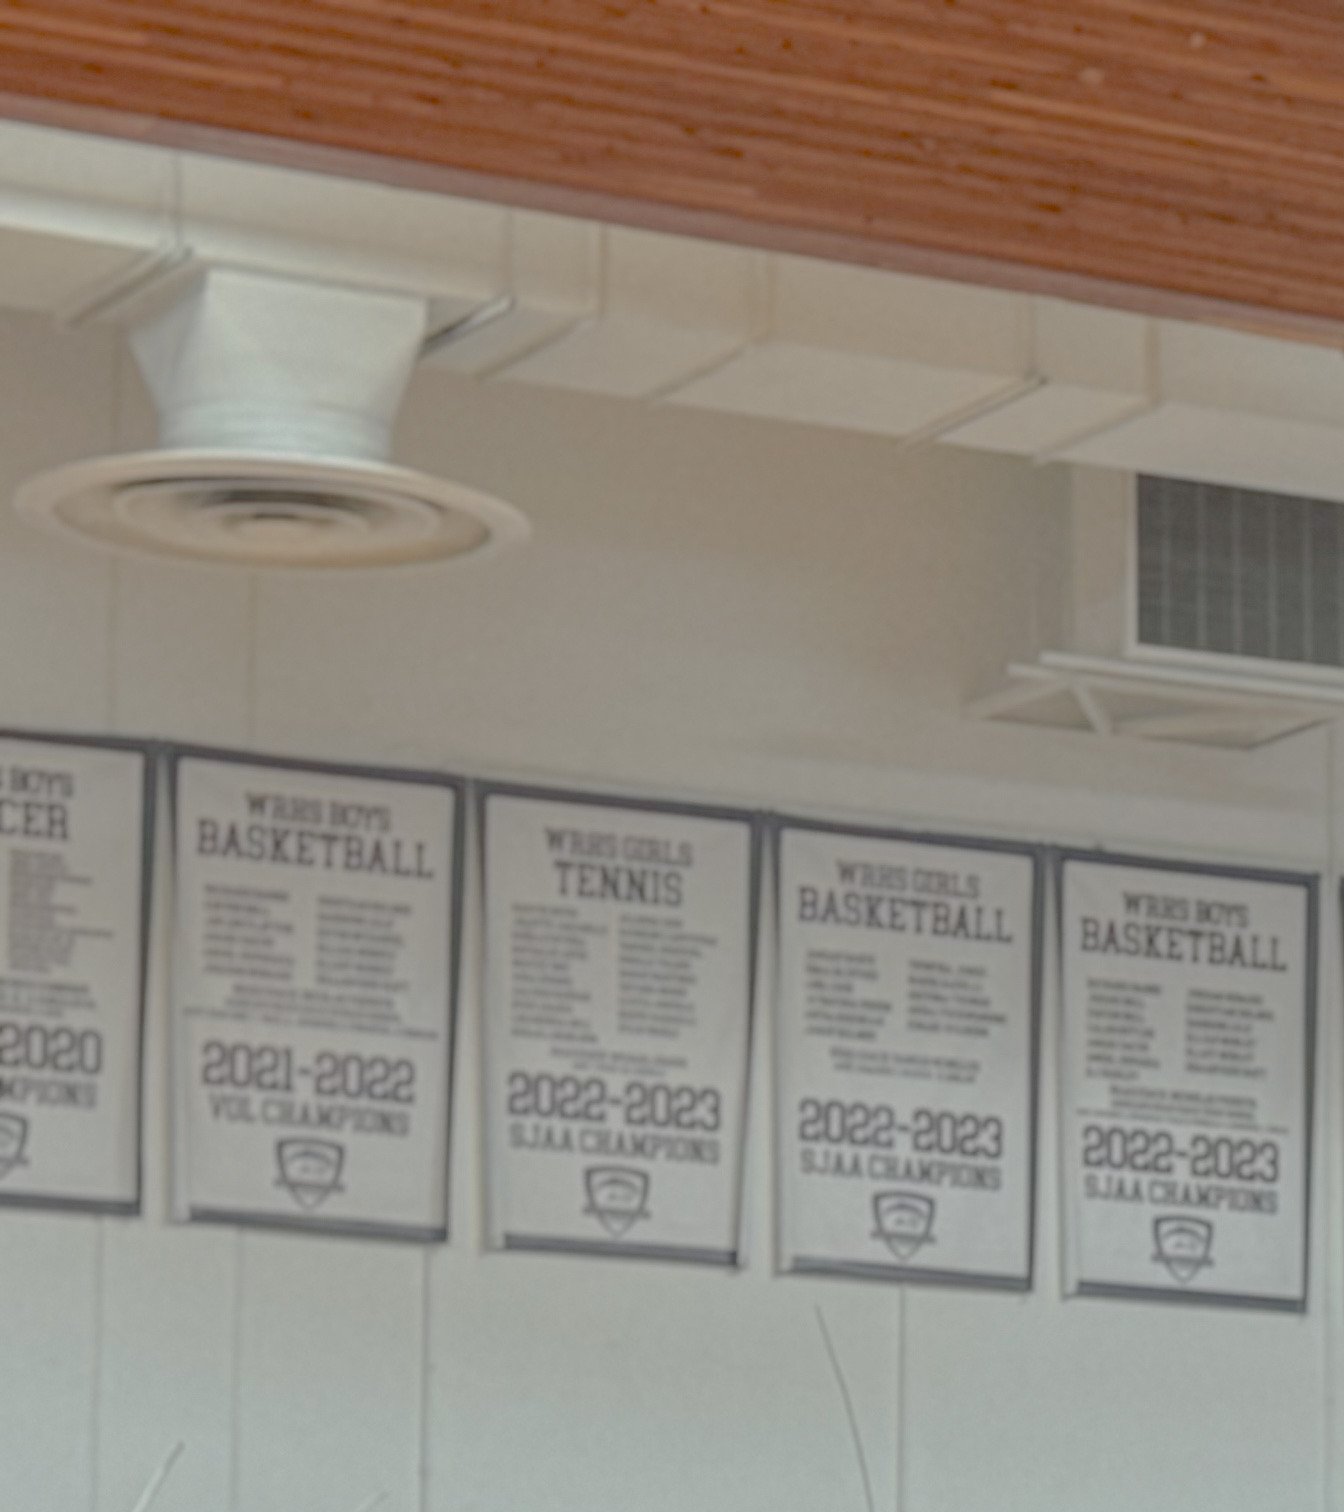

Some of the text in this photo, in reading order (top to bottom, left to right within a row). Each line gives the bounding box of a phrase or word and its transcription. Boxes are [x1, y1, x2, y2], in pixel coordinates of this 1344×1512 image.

[245, 791, 391, 832] WRHS BOYS
[196, 819, 435, 879] BASKETBALL
[545, 827, 693, 868] WRHS GIRLS
[554, 860, 683, 907] TENNIS
[836, 859, 980, 899] WRHS GIRLS
[798, 885, 1013, 943] BASKETBALL
[1122, 892, 1250, 929] WRHS BOYS
[1080, 916, 1287, 972] BASKETBALL
[202, 1040, 415, 1104] 2021-2022
[261, 1097, 411, 1137] CHAMPIONS
[507, 1070, 720, 1132] 2022-2023
[509, 1123, 720, 1165] SJAA CHAMPIONS
[798, 1097, 1002, 1159] 2022-2023
[800, 1149, 1001, 1192] SJAA CHAMPIONS
[1083, 1124, 1279, 1184] 2022-2023
[1149, 1178, 1279, 1216] CHAMPIONS
